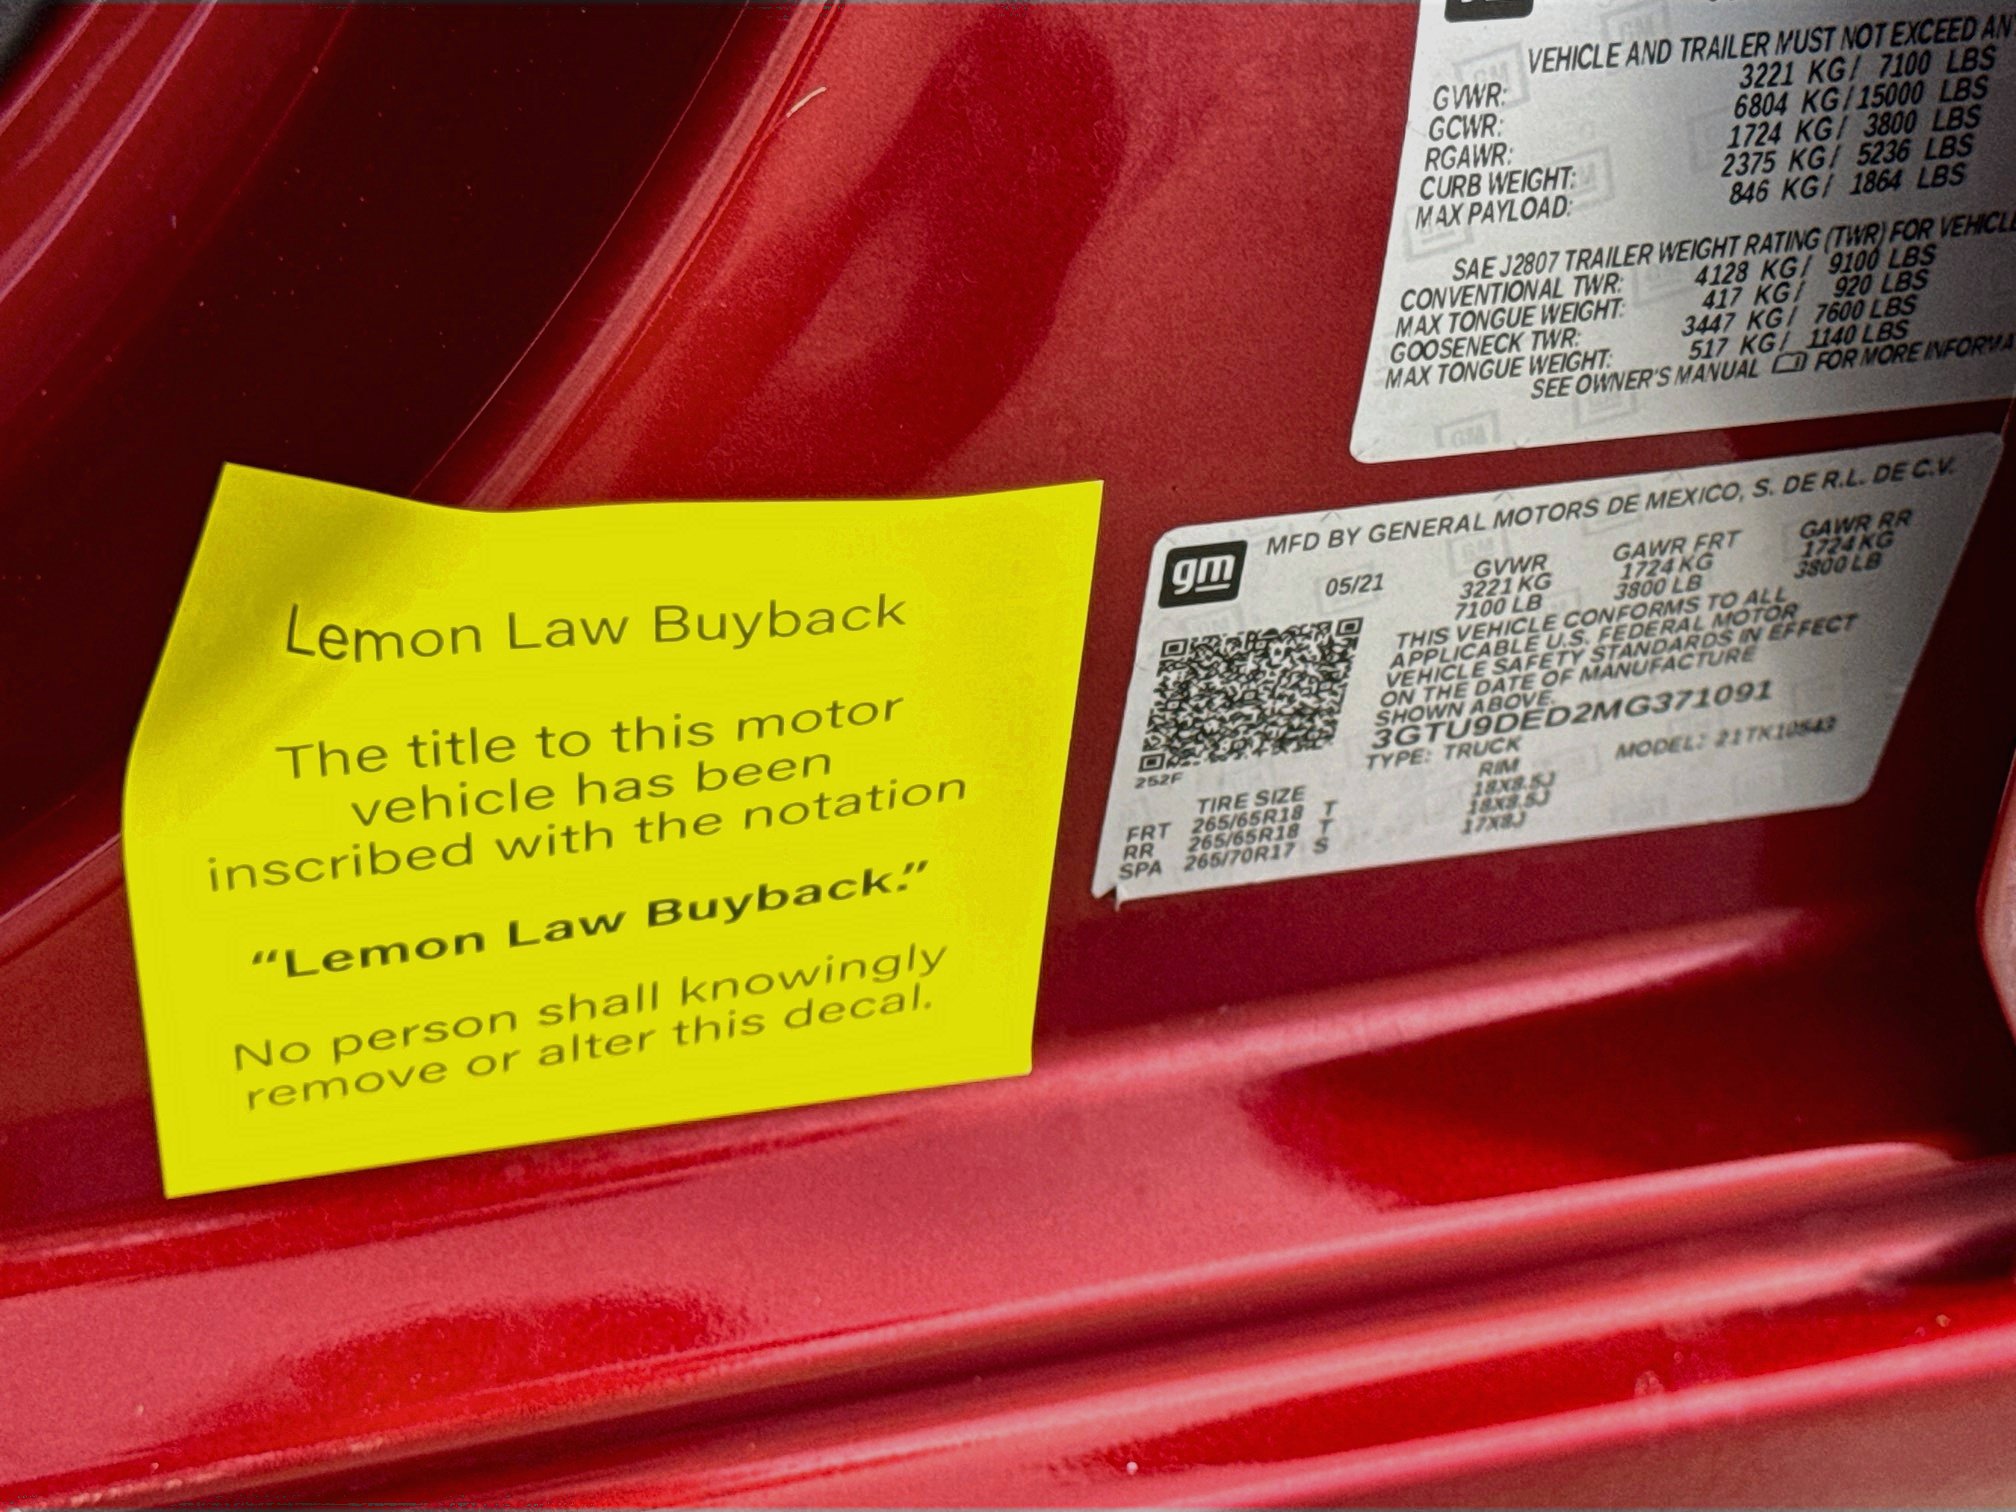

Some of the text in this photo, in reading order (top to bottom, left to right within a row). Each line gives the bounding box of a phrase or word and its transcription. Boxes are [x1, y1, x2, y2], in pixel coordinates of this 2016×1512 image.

[1528, 42, 1622, 74] VEHICLE
[1626, 38, 1672, 66] AND
[1680, 31, 1771, 62] TRAILER
[1775, 26, 1836, 55] MUST
[1842, 23, 1887, 51] NOT
[1891, 16, 1977, 47] EXCEED
[1429, 75, 1989, 141] GCWR: 6804 LBS
[1433, 82, 1508, 111] GVWR:
[1740, 61, 1794, 89] 3221
[1880, 50, 1932, 79] 7100
[1947, 44, 1996, 74] LBS
[1419, 173, 1481, 200] CURB
[1488, 166, 1576, 195] WEIGHT:
[1721, 151, 1776, 178] 2375
[1856, 139, 1911, 166] 5236
[1925, 133, 1975, 161] LBS
[1424, 142, 1514, 172] RGAWR:
[1727, 121, 1782, 149] 1724
[1864, 109, 1917, 138] 3800
[1932, 103, 1982, 132] LBS
[1415, 162, 1967, 230] MAX PAYLOAD: 846 1864 LBS
[1400, 278, 1563, 311] CONVENTIONAL
[1574, 272, 1624, 297] TWR:
[1695, 262, 1748, 286] 4128
[1828, 249, 1879, 274] 9100
[1888, 244, 1937, 269] LBS
[1452, 218, 1935, 281] SAE J2807 TRAILER WEIGHT RATING (TWR) FOR
[1390, 294, 1917, 364] GOOSENECK TWR: 3447 7600 LBS
[1395, 269, 1930, 338] MAX TONGUE WEIGHT: 417 920 LBS
[1385, 320, 1910, 389] MAX TONGUE WEIGHT: 517 1140 LBS
[1531, 341, 1919, 400] SEE OWNER'S MANUAL FOR MORE
[1266, 457, 1955, 556] MFD BY GENERAL MOTORS DE MEXICO, S. DE R.L. DE C.V.
[1799, 509, 1913, 540] GAWR RR
[1172, 554, 1236, 596] gm
[1473, 554, 1548, 578] GVWR
[1612, 529, 1742, 562] GAWR FRT
[1620, 552, 1714, 580] 1724 KG
[1802, 530, 1895, 559] 1724 KG
[1852, 552, 1883, 572] LB
[1324, 572, 1385, 597] 05/21
[1454, 594, 1543, 620] 7100 LB
[1459, 572, 1553, 600] 3221 KG
[1613, 575, 1703, 601] 3800 LB
[286, 593, 907, 663] Lemon Law Buyback
[1389, 602, 1798, 670] APPLICABLE U.S. FEDERAL MOTOR
[1398, 586, 1787, 650] THIS VEHICLE CONFORMS TO ALL
[1380, 645, 1757, 708] ON THE DATE OF MANUFACTURE
[1386, 613, 1859, 688] VEHICLE SAFETY STANDARDS IN EFFECT
[274, 697, 904, 779] The title to this motor
[1370, 679, 1772, 751] 3GTU9DED2MG371091
[1374, 689, 1555, 728] SHOWN ABOVE.
[1134, 772, 1185, 789] 252F
[1365, 751, 1432, 771] TYPE:
[1443, 735, 1523, 760] TRUCK
[352, 753, 832, 826] vehicle has been
[1199, 757, 1521, 814] TIRE SIZE RIM
[208, 777, 966, 892] inscribed with the notation
[1122, 822, 1300, 861] RR 265/65R18
[1126, 804, 1305, 843] FRT 265/65R18
[1118, 842, 1296, 880] SPA 265/70R17
[251, 859, 929, 978] “Lemon Law Buyback.”
[234, 943, 947, 1071] No person shall knowingly
[247, 982, 933, 1111] remove or alter this decal.
